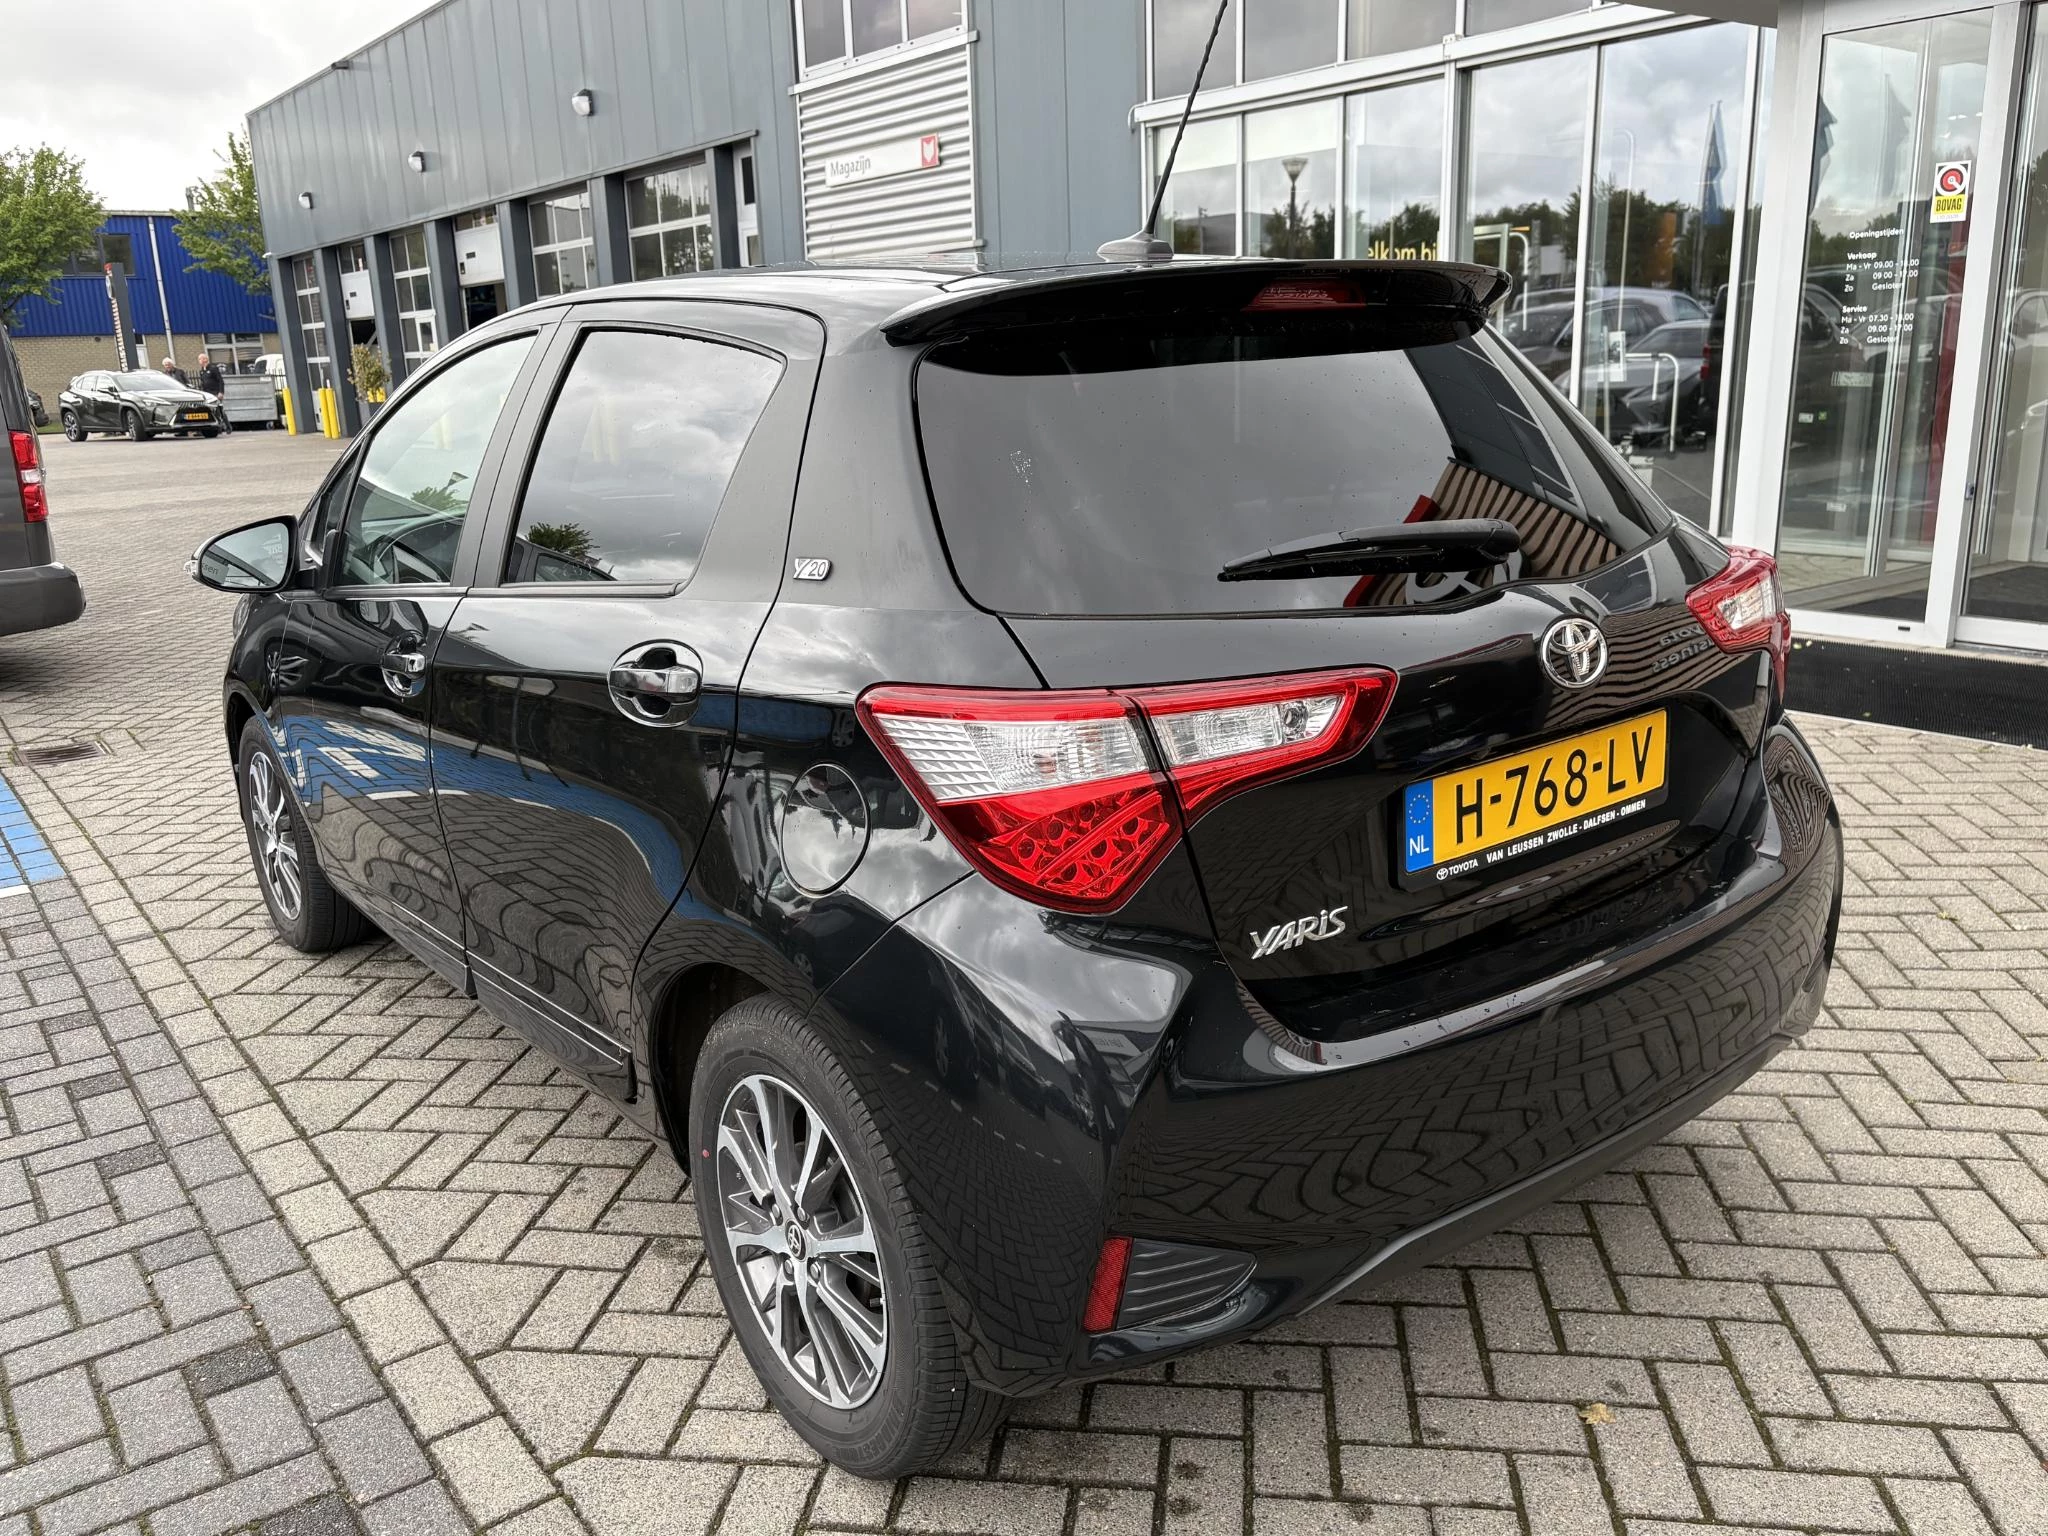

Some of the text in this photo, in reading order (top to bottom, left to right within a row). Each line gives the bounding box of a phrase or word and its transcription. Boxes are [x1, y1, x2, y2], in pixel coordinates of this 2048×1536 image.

[831, 155, 871, 178] Magazijn
[1936, 198, 1962, 212] BOVAG
[1849, 228, 1904, 240] Openingstijden
[1847, 252, 1877, 261] Verkoop
[1846, 263, 1857, 271] Ma
[1863, 262, 1871, 270] Vr
[1873, 260, 1893, 269] 09.00
[1844, 284, 1854, 292] Zo
[1842, 305, 1868, 313] Service
[1841, 316, 1852, 324] Ma
[1868, 314, 1888, 322] 07.30
[1840, 326, 1849, 334] Za
[1867, 325, 1887, 333] 09.00
[1409, 726, 1653, 856] NL H-768-LV
[1449, 859, 1478, 875] TOYOTA
[1487, 850, 1504, 864] VAN
[1508, 836, 1543, 857] LEUSSEN
[1547, 824, 1578, 843] ZWOLLE
[1583, 811, 1616, 830] DALFSEN
[1621, 799, 1646, 816] OMMEN
